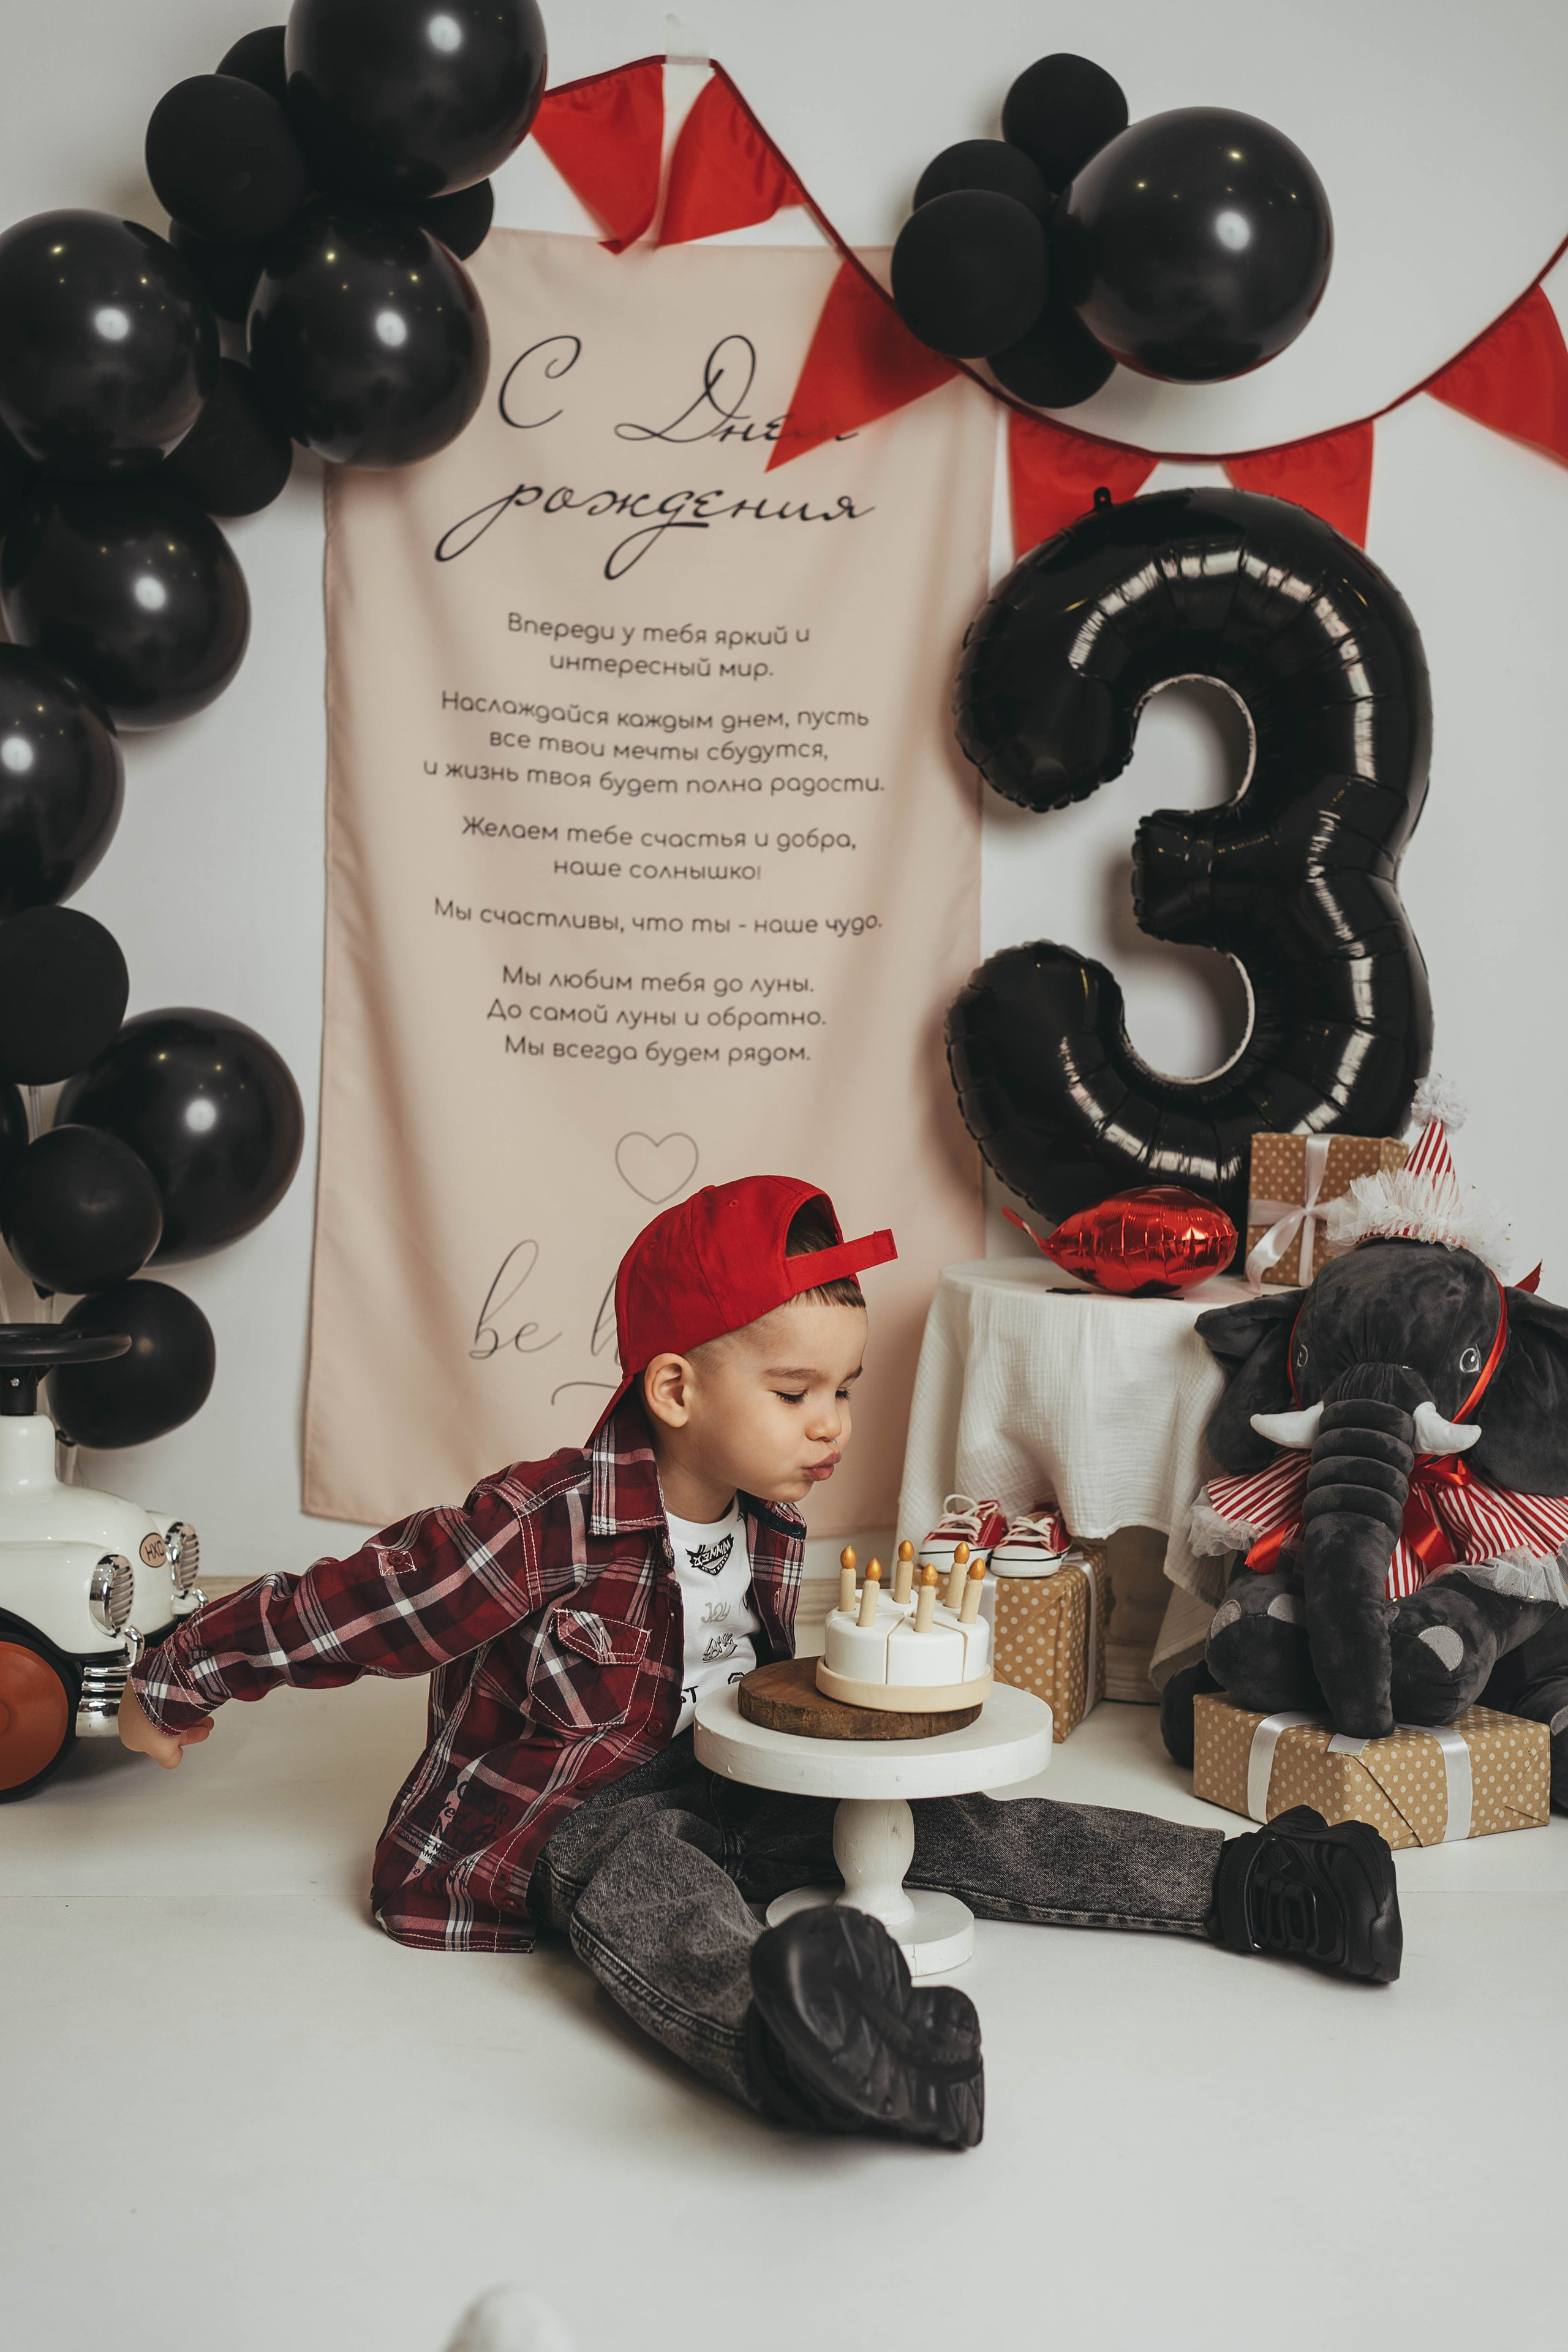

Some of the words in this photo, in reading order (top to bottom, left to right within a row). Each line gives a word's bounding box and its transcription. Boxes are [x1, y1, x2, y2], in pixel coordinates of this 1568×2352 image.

[498, 334, 582, 429] С
[613, 334, 859, 443] Дне
[434, 483, 876, 581] рождения
[508, 611, 615, 644] Впереди
[620, 627, 636, 647] у
[643, 622, 707, 644] тебя
[715, 625, 788, 650] яркий
[795, 628, 810, 643] и
[549, 655, 711, 679] интересный
[719, 662, 774, 681] мир.
[442, 690, 609, 725] Наслаждайся
[617, 712, 713, 734] каждым
[721, 712, 790, 734] днем,
[797, 710, 870, 731] пусть
[489, 731, 532, 749] все
[538, 736, 605, 758] твои
[613, 744, 699, 761] мечты
[706, 740, 828, 766] сбудутся,
[423, 761, 438, 775] и
[445, 763, 519, 783] жизнь
[527, 768, 592, 788] твоя
[599, 771, 678, 797] будет
[686, 777, 763, 794] полна
[770, 777, 884, 797] радости.
[461, 815, 559, 841] Желаем
[567, 824, 633, 846] тебе
[640, 832, 746, 848] счастья
[754, 833, 769, 848] и
[776, 827, 856, 853] добра,
[554, 860, 622, 878] наше
[629, 864, 761, 881] солнышко!
[434, 897, 472, 921] Мы
[480, 908, 625, 934] счастливы,
[631, 917, 684, 933] что
[692, 918, 731, 933] ты
[754, 918, 819, 934] наше
[825, 914, 882, 938] чудо.
[502, 964, 541, 987] Мы
[549, 968, 633, 990] любим
[641, 971, 706, 993] тебя
[713, 978, 744, 998] до
[750, 978, 814, 998] луны.
[486, 998, 522, 1022] До
[529, 1004, 608, 1024] самой
[616, 1010, 676, 1030] луны
[684, 1012, 699, 1027] и
[707, 1006, 826, 1031] обратно.
[505, 1034, 545, 1057] Мы
[552, 1042, 638, 1065] всегда
[645, 1040, 720, 1067] будем
[728, 1046, 811, 1067] рядом.
[467, 1236, 565, 1362] be
[145, 1540, 164, 1561] HXC
[693, 1539, 731, 1566] WINNER
